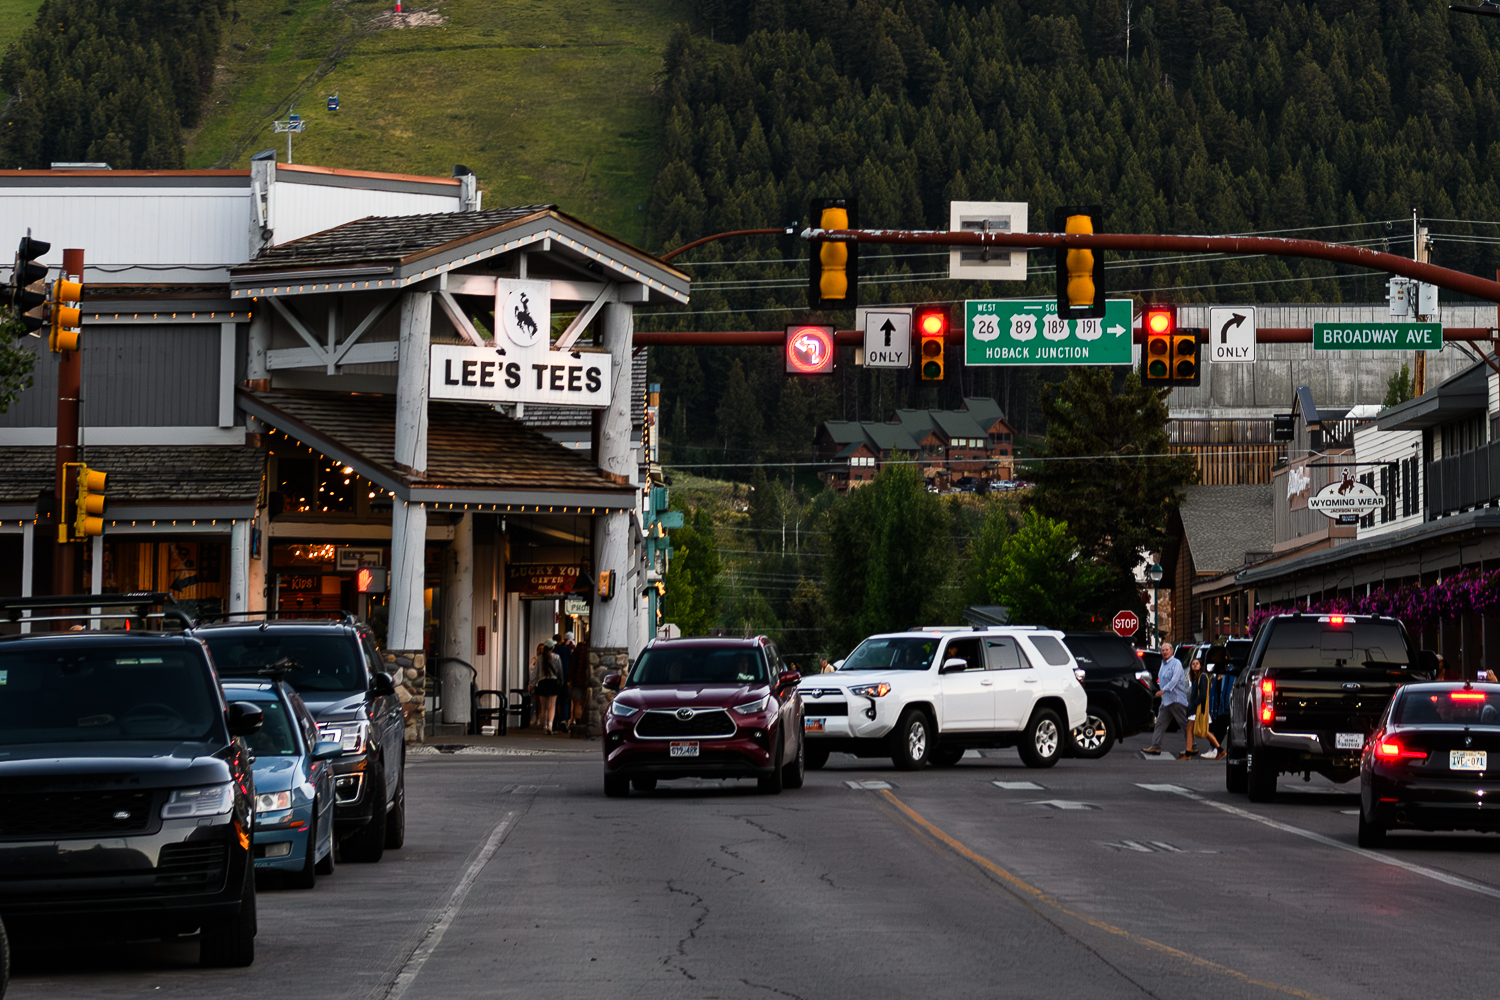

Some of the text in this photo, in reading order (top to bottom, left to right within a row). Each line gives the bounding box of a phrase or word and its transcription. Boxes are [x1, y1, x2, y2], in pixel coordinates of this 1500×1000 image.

[977, 303, 996, 312] WEST
[978, 320, 1097, 334] 26 89 189 191
[1323, 329, 1432, 344] BROADWAY AVE
[870, 351, 903, 363] ONLY
[986, 346, 1089, 359] HOBACK JUNCTION
[1217, 346, 1249, 358] ONLY
[445, 359, 602, 393] LEE'S TEES
[1310, 497, 1384, 507] WYOMING WEAR
[510, 565, 555, 578] LUCKY
[531, 576, 564, 584] GIFTS
[1115, 618, 1137, 629] STOP
